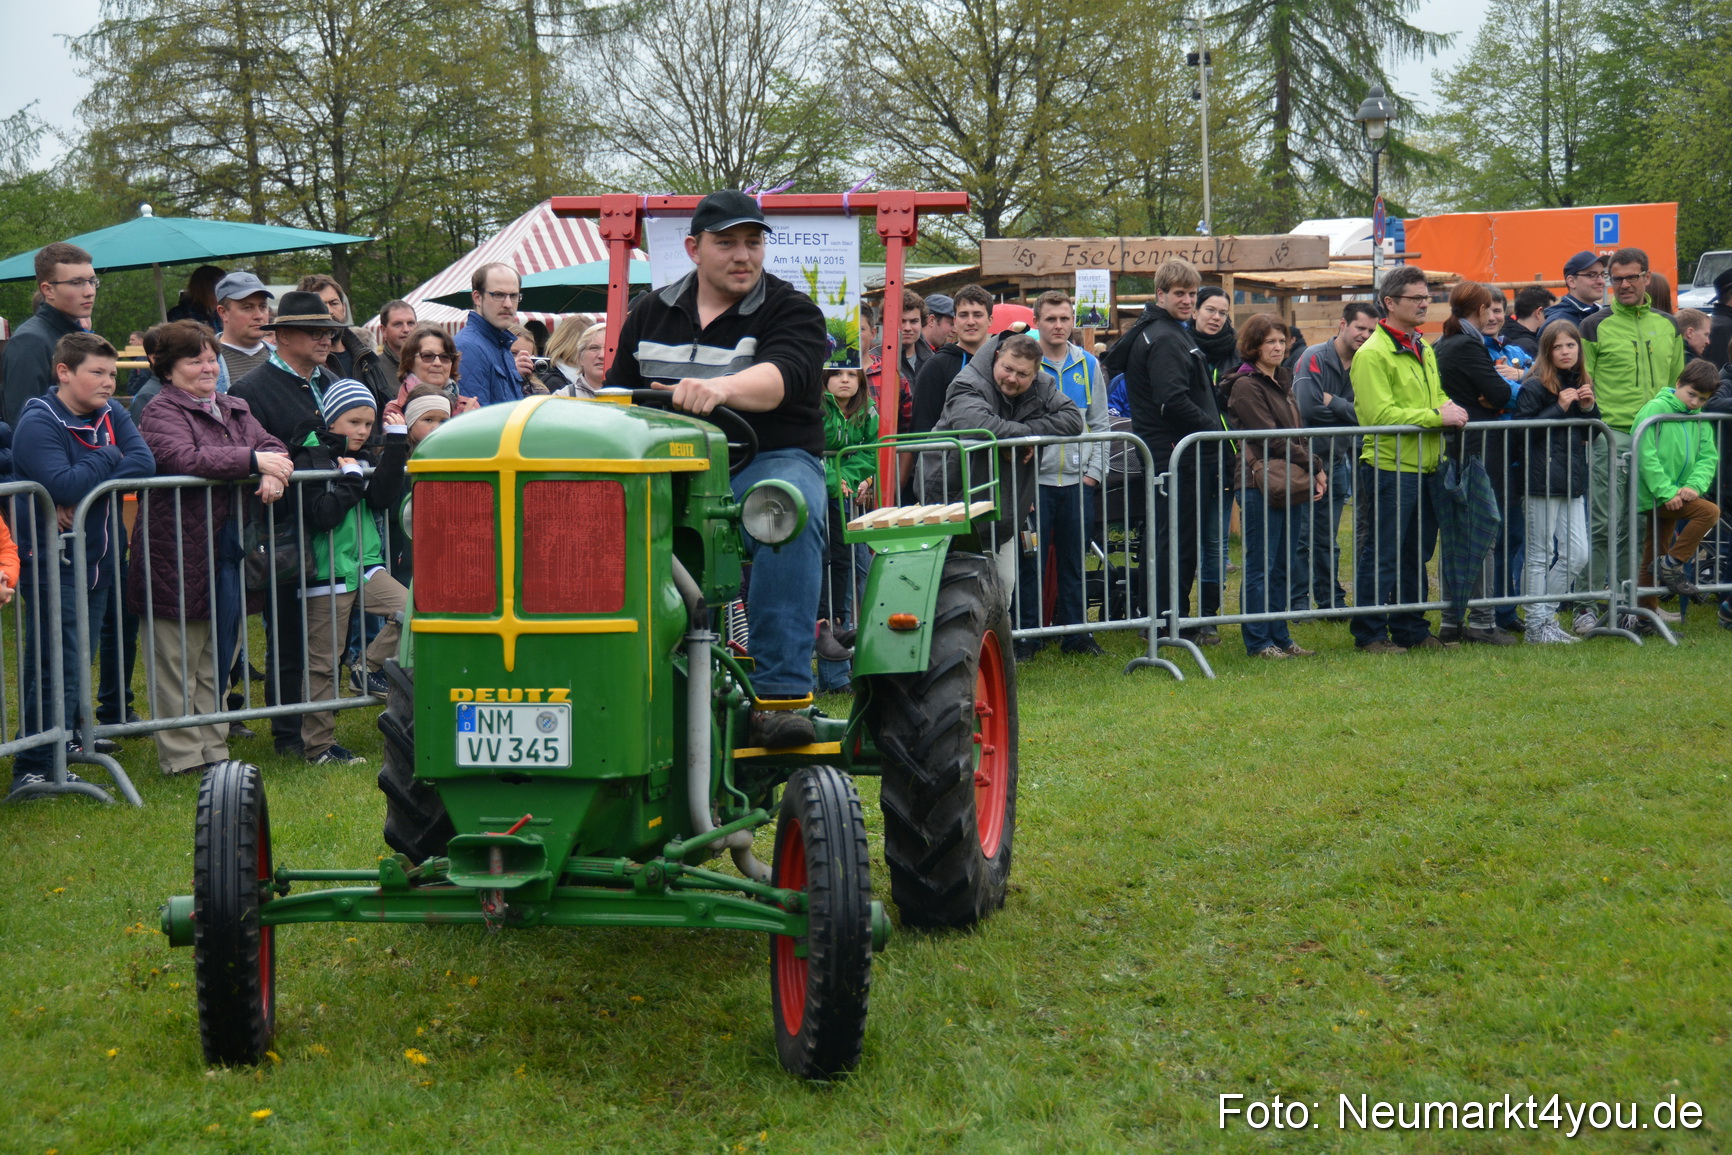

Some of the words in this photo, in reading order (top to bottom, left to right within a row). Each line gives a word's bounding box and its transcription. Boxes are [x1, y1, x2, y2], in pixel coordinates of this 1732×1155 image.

[1600, 217, 1613, 241] P
[773, 255, 788, 264] Am
[790, 256, 803, 265] 14.
[805, 256, 821, 265] MAI
[823, 256, 845, 265] 2015
[1061, 242, 1239, 267] Eselrennstall
[669, 442, 695, 457] DEUTZ
[450, 688, 572, 703] DEUTZ
[464, 721, 471, 731] D
[478, 709, 513, 735] NM
[468, 737, 502, 762] VV
[508, 737, 559, 763] 345
